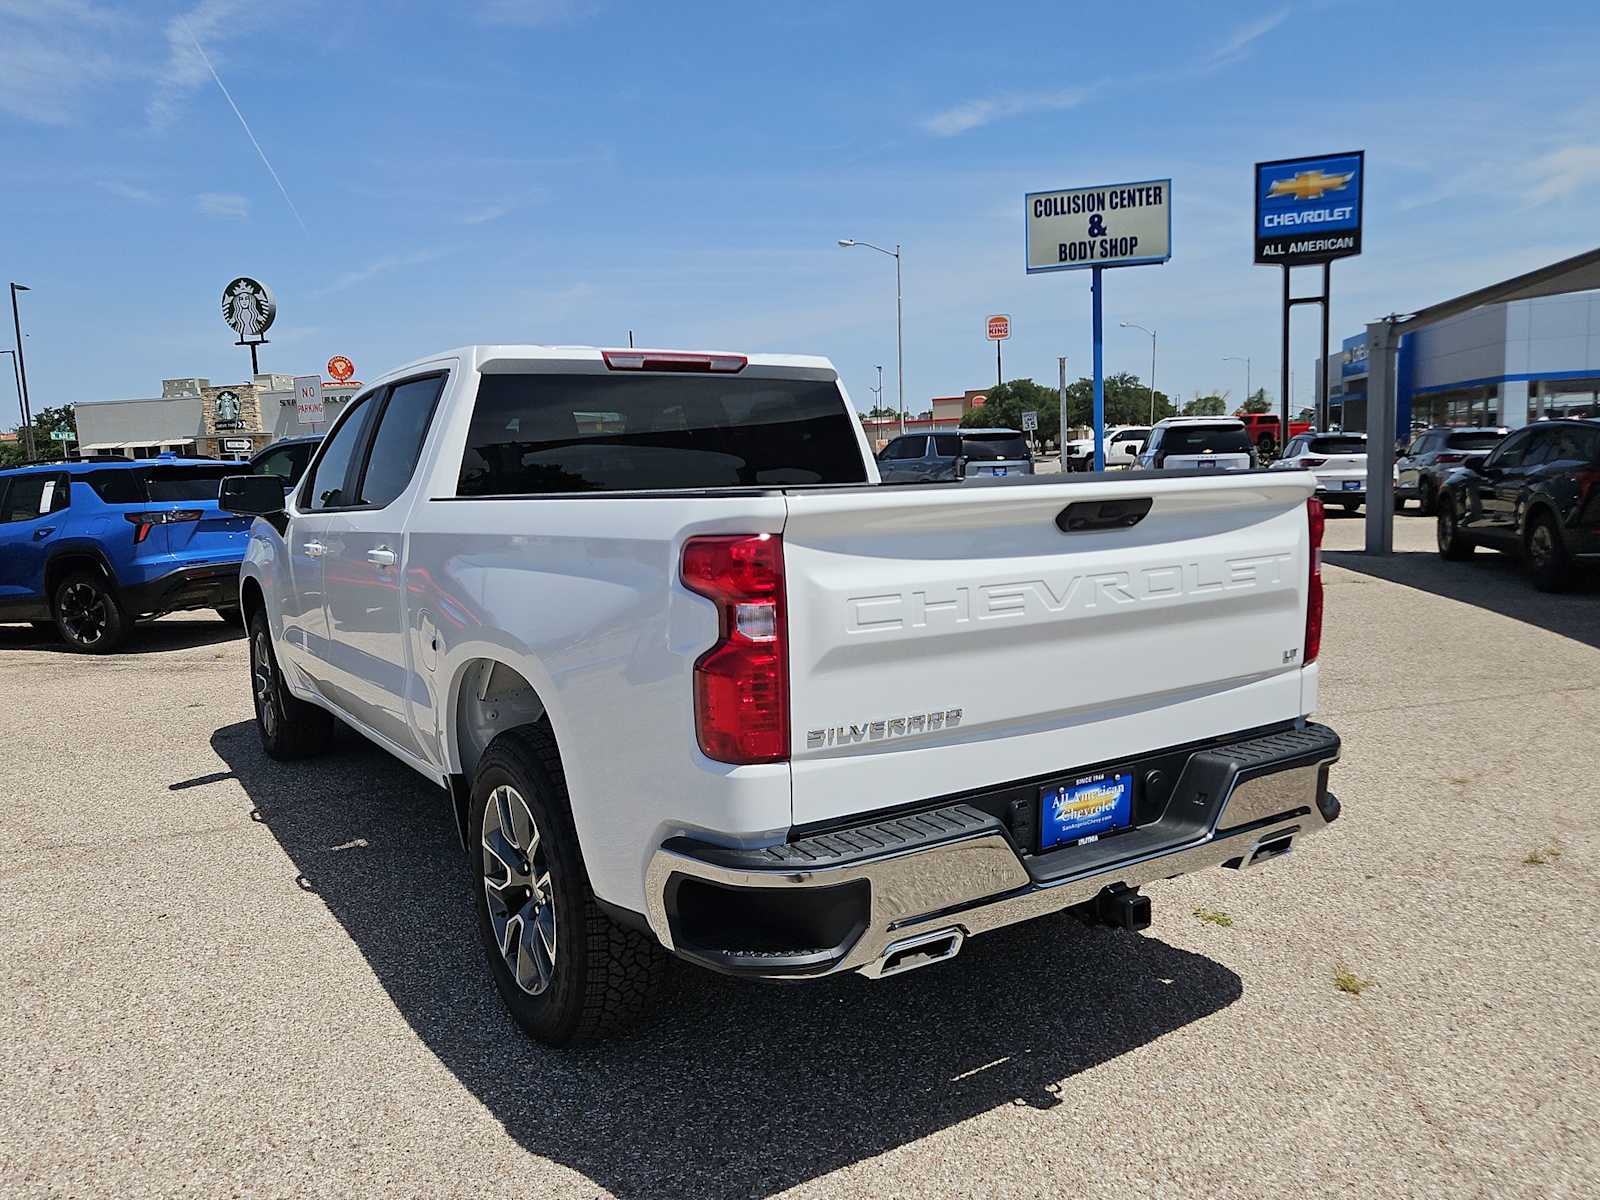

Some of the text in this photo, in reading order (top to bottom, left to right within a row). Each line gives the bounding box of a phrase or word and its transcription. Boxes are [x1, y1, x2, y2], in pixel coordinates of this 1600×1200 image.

[1034, 186, 1163, 218] COLLISION CENTER
[1088, 214, 1107, 238] &
[1264, 206, 1353, 228] CHEVROLET
[1058, 236, 1139, 262] BODY SHOP
[1263, 237, 1354, 257] ALL AMERICAN
[988, 327, 1008, 335] KING
[302, 386, 315, 398] NO
[297, 403, 323, 414] PARKING
[845, 552, 1292, 635] CHEVROLET
[1281, 648, 1298, 664] LT
[806, 708, 963, 749] SILVERADO
[1075, 776, 1092, 785] SINCE
[1052, 783, 1125, 809] All American
[1062, 800, 1116, 821] Chevrolet
